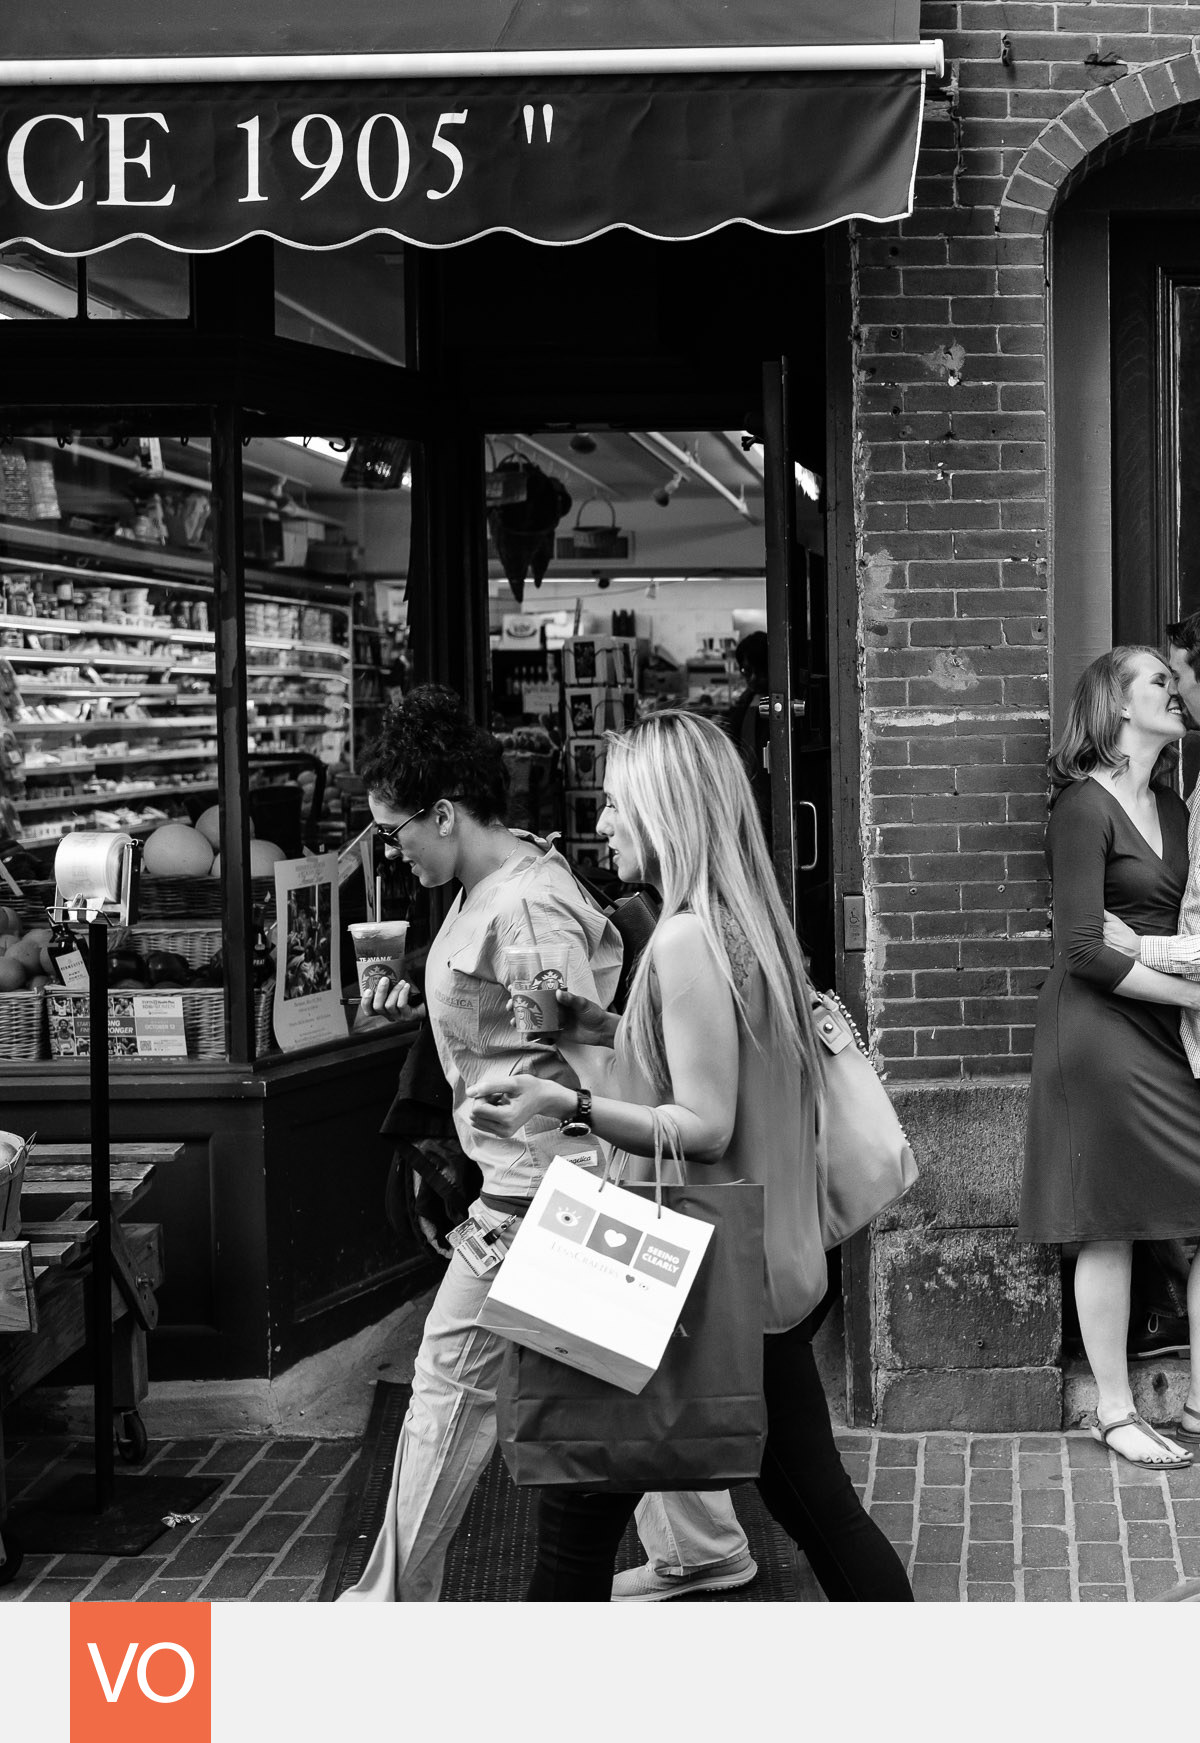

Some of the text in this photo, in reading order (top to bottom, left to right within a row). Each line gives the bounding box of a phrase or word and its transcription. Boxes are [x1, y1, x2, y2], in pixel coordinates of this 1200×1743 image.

[7, 112, 175, 210] CE
[237, 108, 469, 203] 1905
[641, 1252, 680, 1274] CLEARLY
[648, 1246, 680, 1265] SEEING
